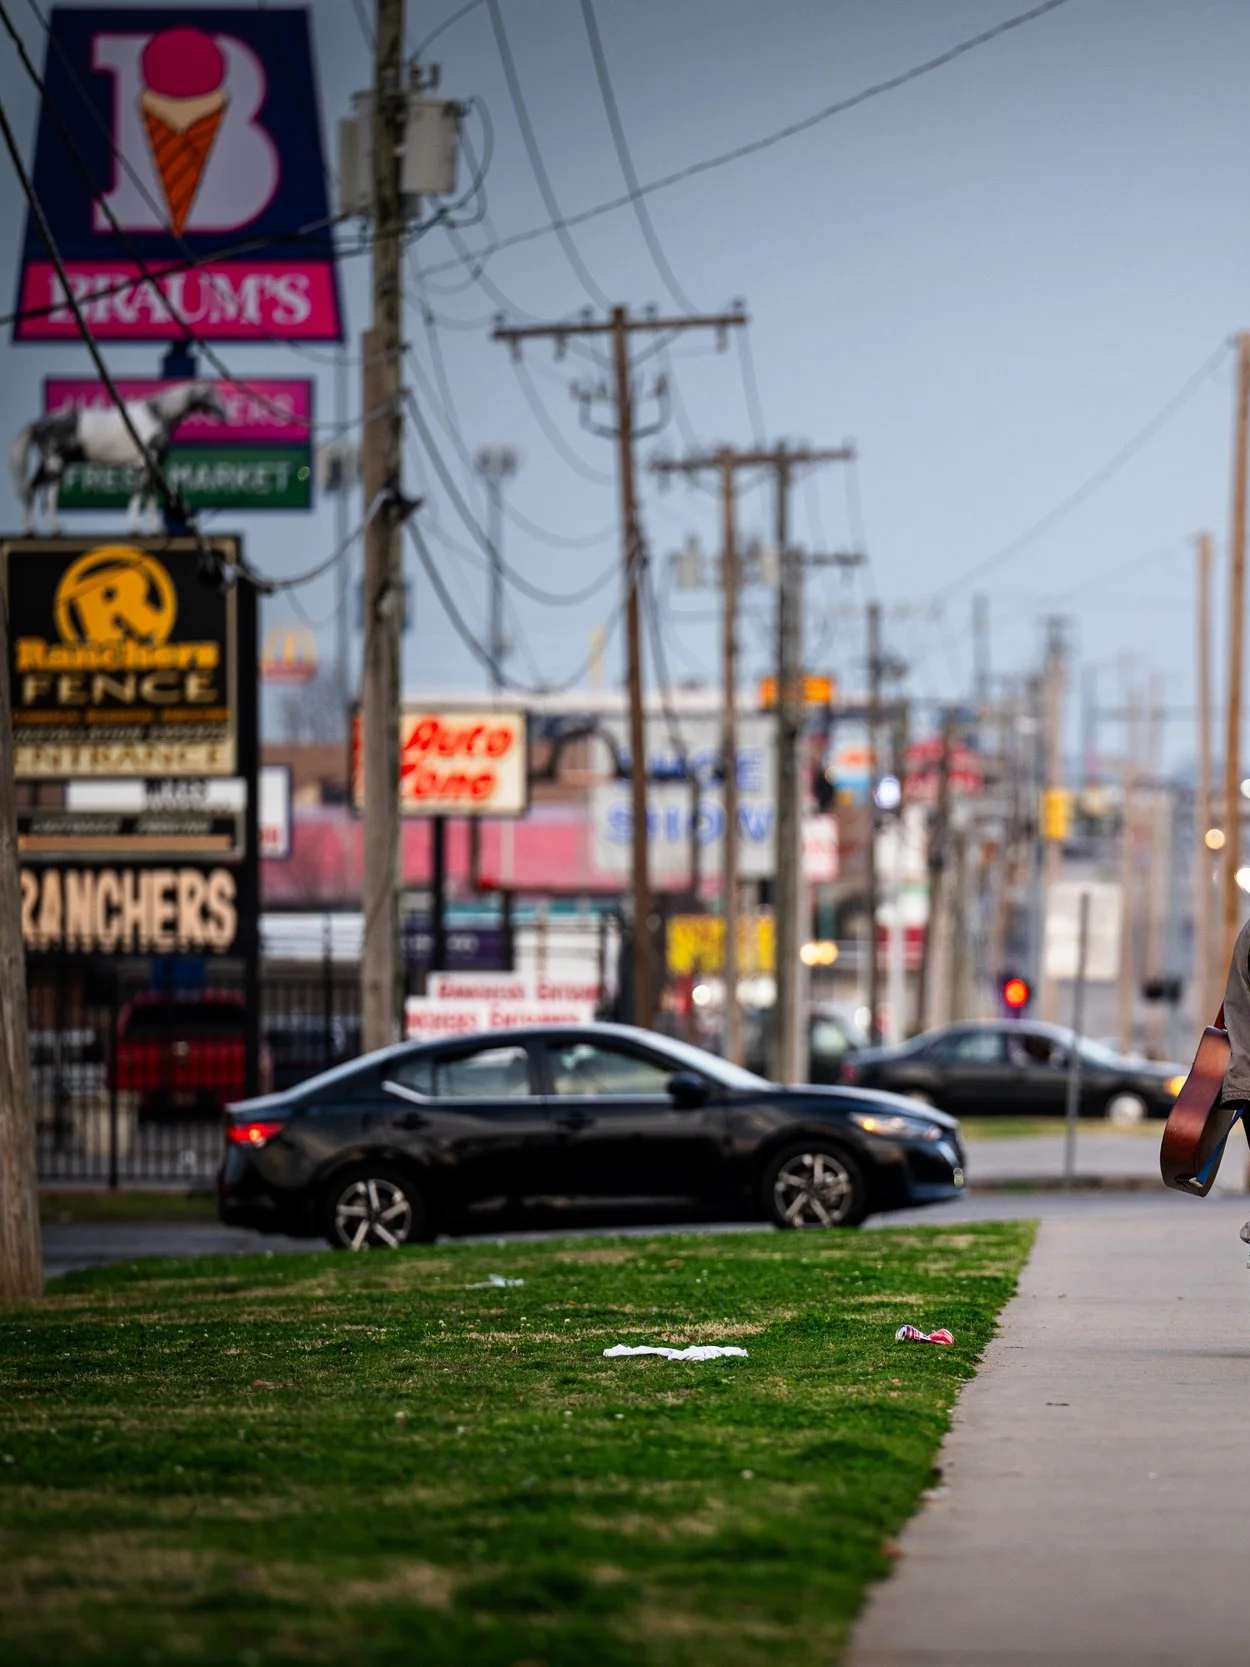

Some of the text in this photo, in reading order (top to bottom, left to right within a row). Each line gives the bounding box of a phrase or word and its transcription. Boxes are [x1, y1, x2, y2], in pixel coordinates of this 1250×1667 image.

[48, 272, 311, 325] BRAUM'S
[169, 459, 292, 496] MARKET
[22, 671, 218, 704] FENCE
[403, 717, 513, 757] Auto
[14, 742, 219, 771] ENTRANCE
[21, 868, 237, 952] RANCHERS
